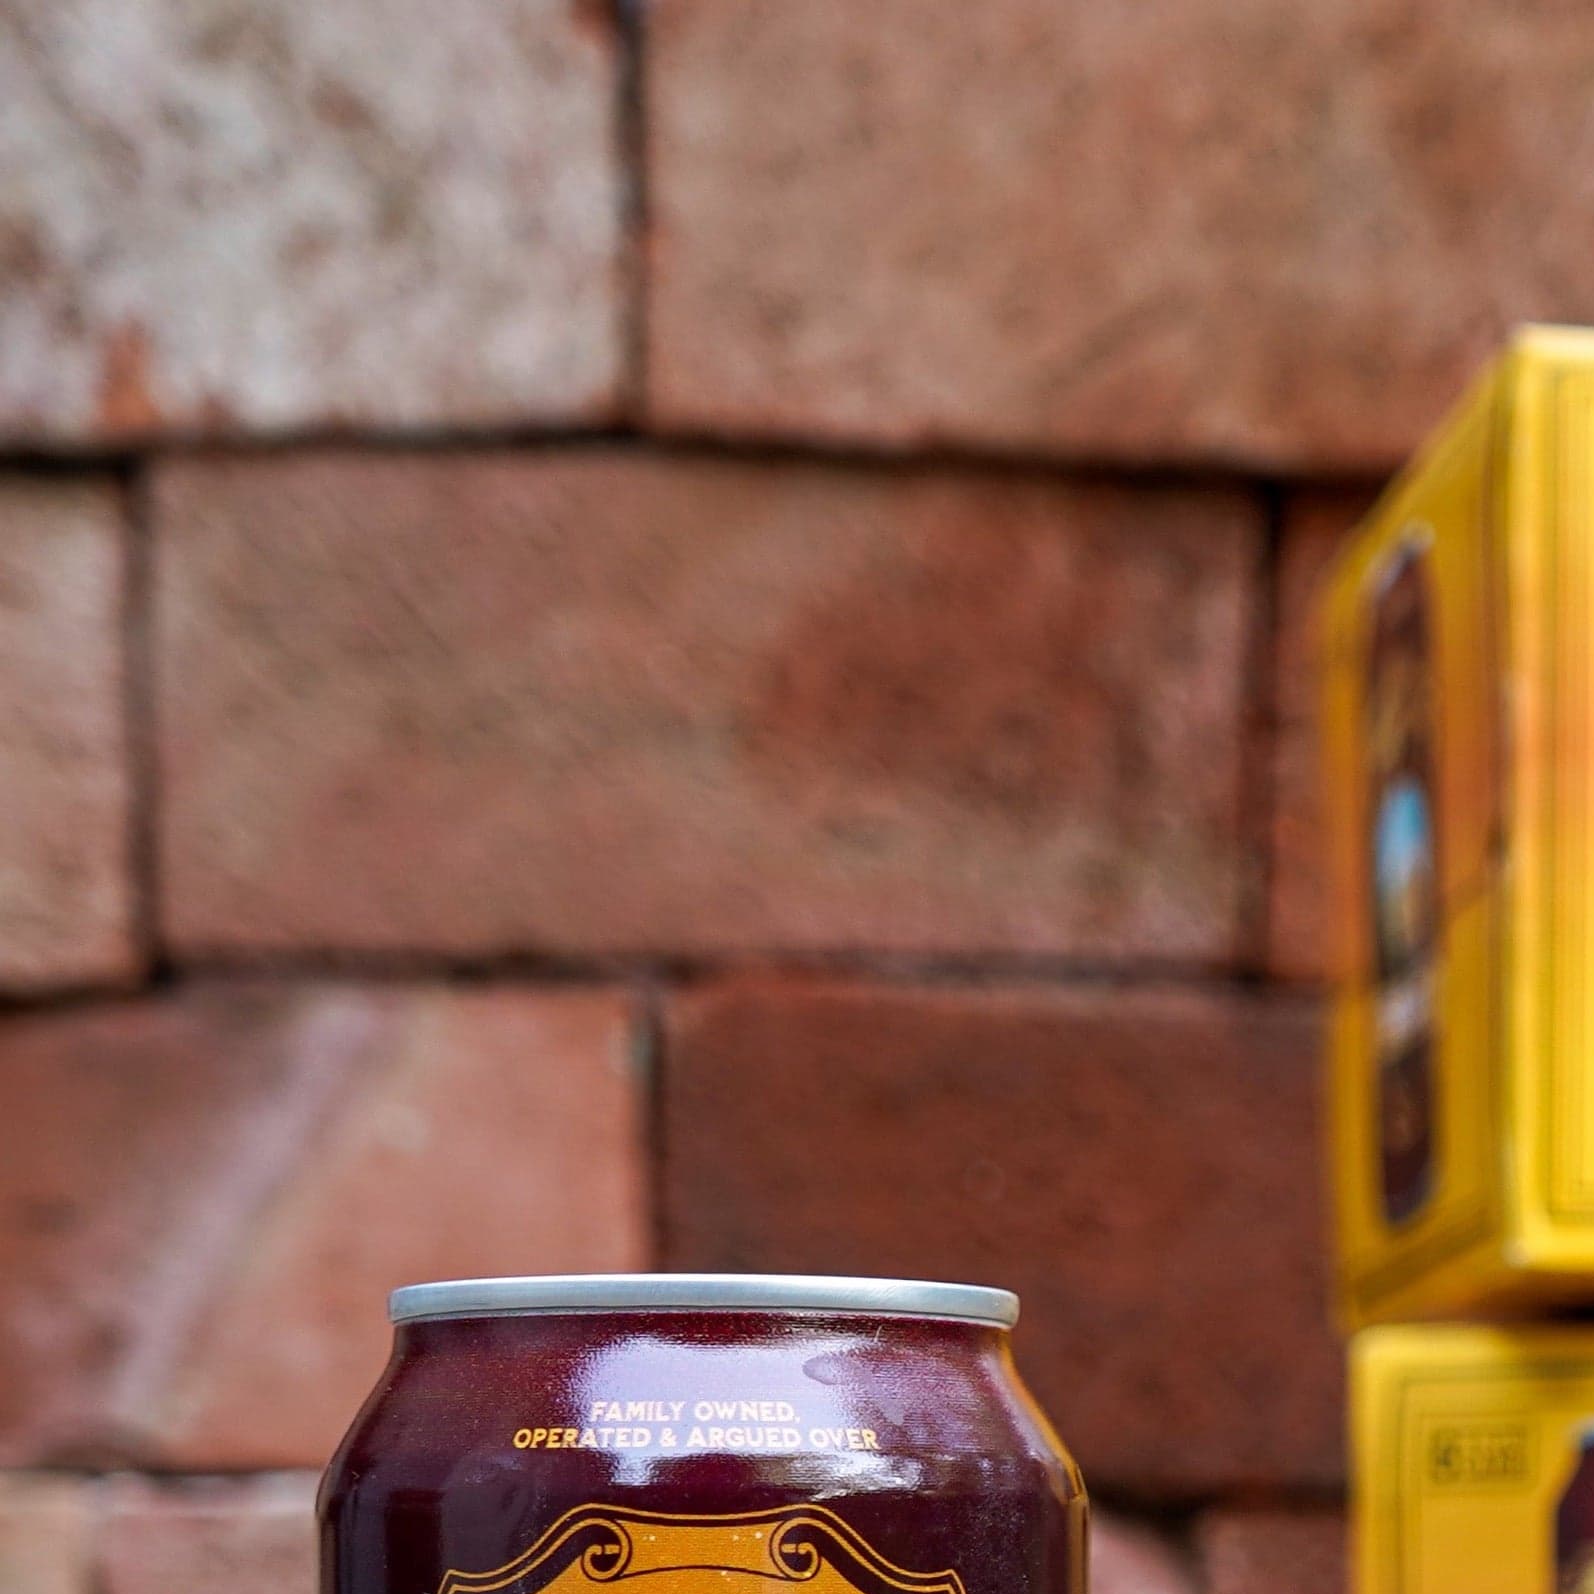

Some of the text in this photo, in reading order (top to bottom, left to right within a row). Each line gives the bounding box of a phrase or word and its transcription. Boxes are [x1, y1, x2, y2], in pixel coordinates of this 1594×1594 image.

[589, 1400, 801, 1425] FAMILY OWNED,
[512, 1427, 881, 1451] OPERATED & ARGUED OVER
